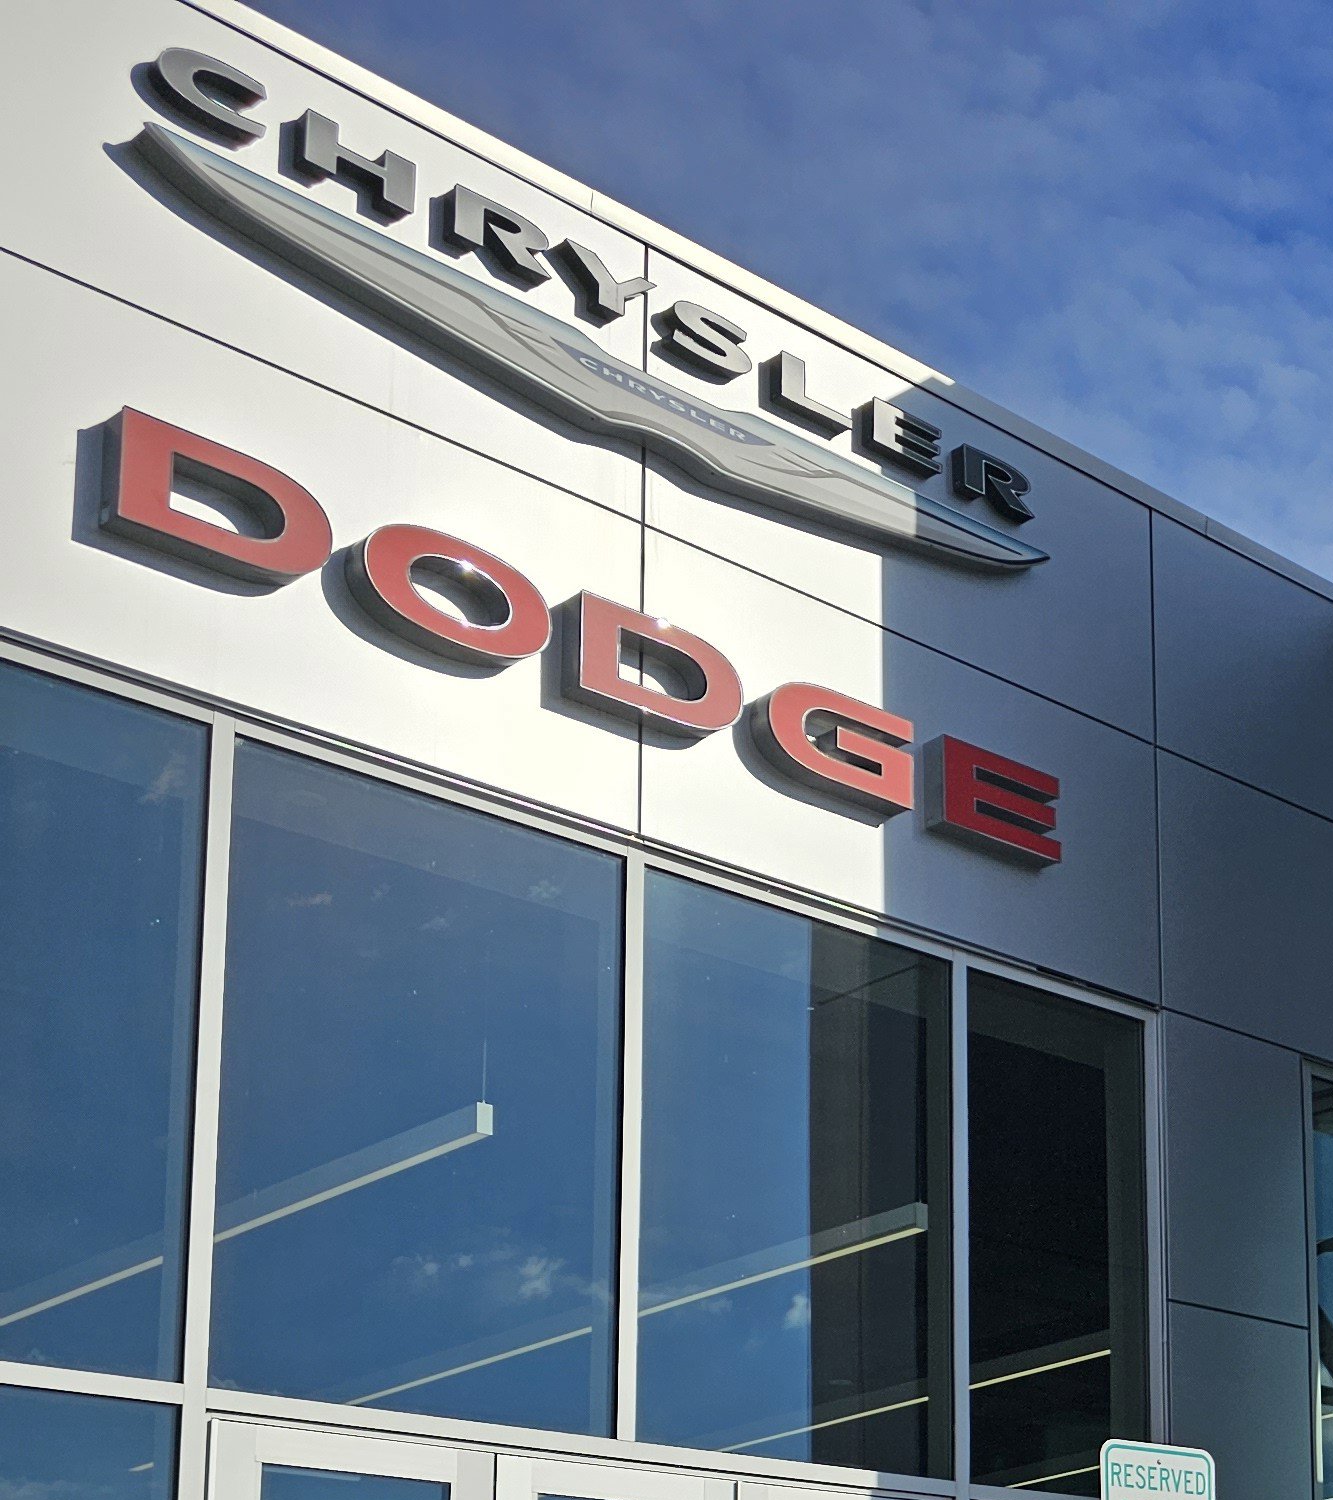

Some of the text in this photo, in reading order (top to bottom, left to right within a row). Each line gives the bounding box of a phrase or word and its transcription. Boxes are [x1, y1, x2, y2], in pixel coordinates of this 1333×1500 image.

[142, 46, 1035, 522] CHRYSLER
[579, 356, 747, 441] CHRYSLER
[102, 404, 1062, 866] DODGE
[1110, 1462, 1206, 1495] RESERVED
